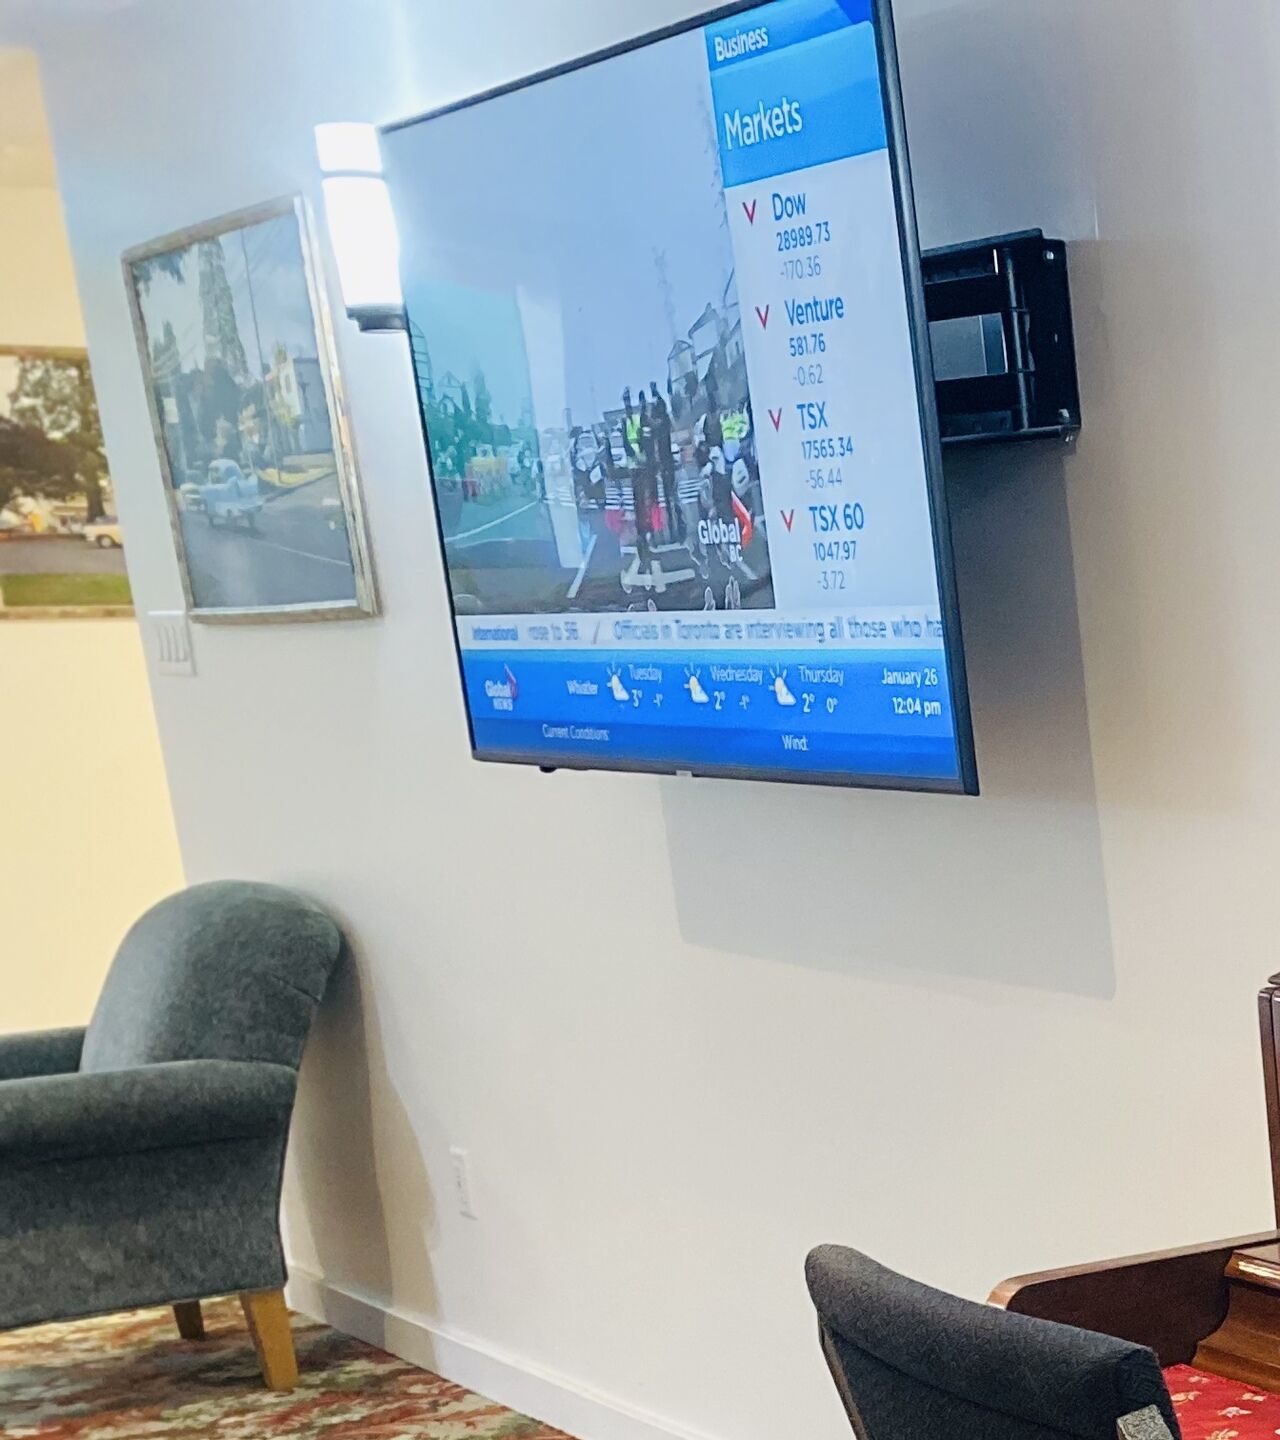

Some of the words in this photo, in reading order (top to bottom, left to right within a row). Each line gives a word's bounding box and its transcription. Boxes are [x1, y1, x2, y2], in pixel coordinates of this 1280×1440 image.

[714, 26, 769, 62] Business
[723, 96, 803, 150] Markets
[772, 193, 806, 221] Dow
[776, 221, 831, 251] 28989.73
[780, 255, 821, 280] -170.36
[784, 296, 844, 326] Venture
[789, 333, 826, 357] 581.76
[793, 364, 824, 386] -0.62
[797, 402, 828, 431] TSX
[801, 435, 854, 460] 17565.34
[805, 468, 843, 489] -56.44
[809, 506, 840, 533] TSX
[843, 502, 864, 530] 60
[698, 518, 741, 545] Global
[813, 540, 857, 561] 1047.97
[847, 614, 887, 639] those
[891, 614, 922, 639] who
[710, 664, 763, 686] Wednesday
[799, 665, 844, 687] Thursday
[881, 668, 921, 688] January
[924, 668, 938, 686] 26
[892, 696, 921, 714] 12:04
[924, 701, 941, 718] pm
